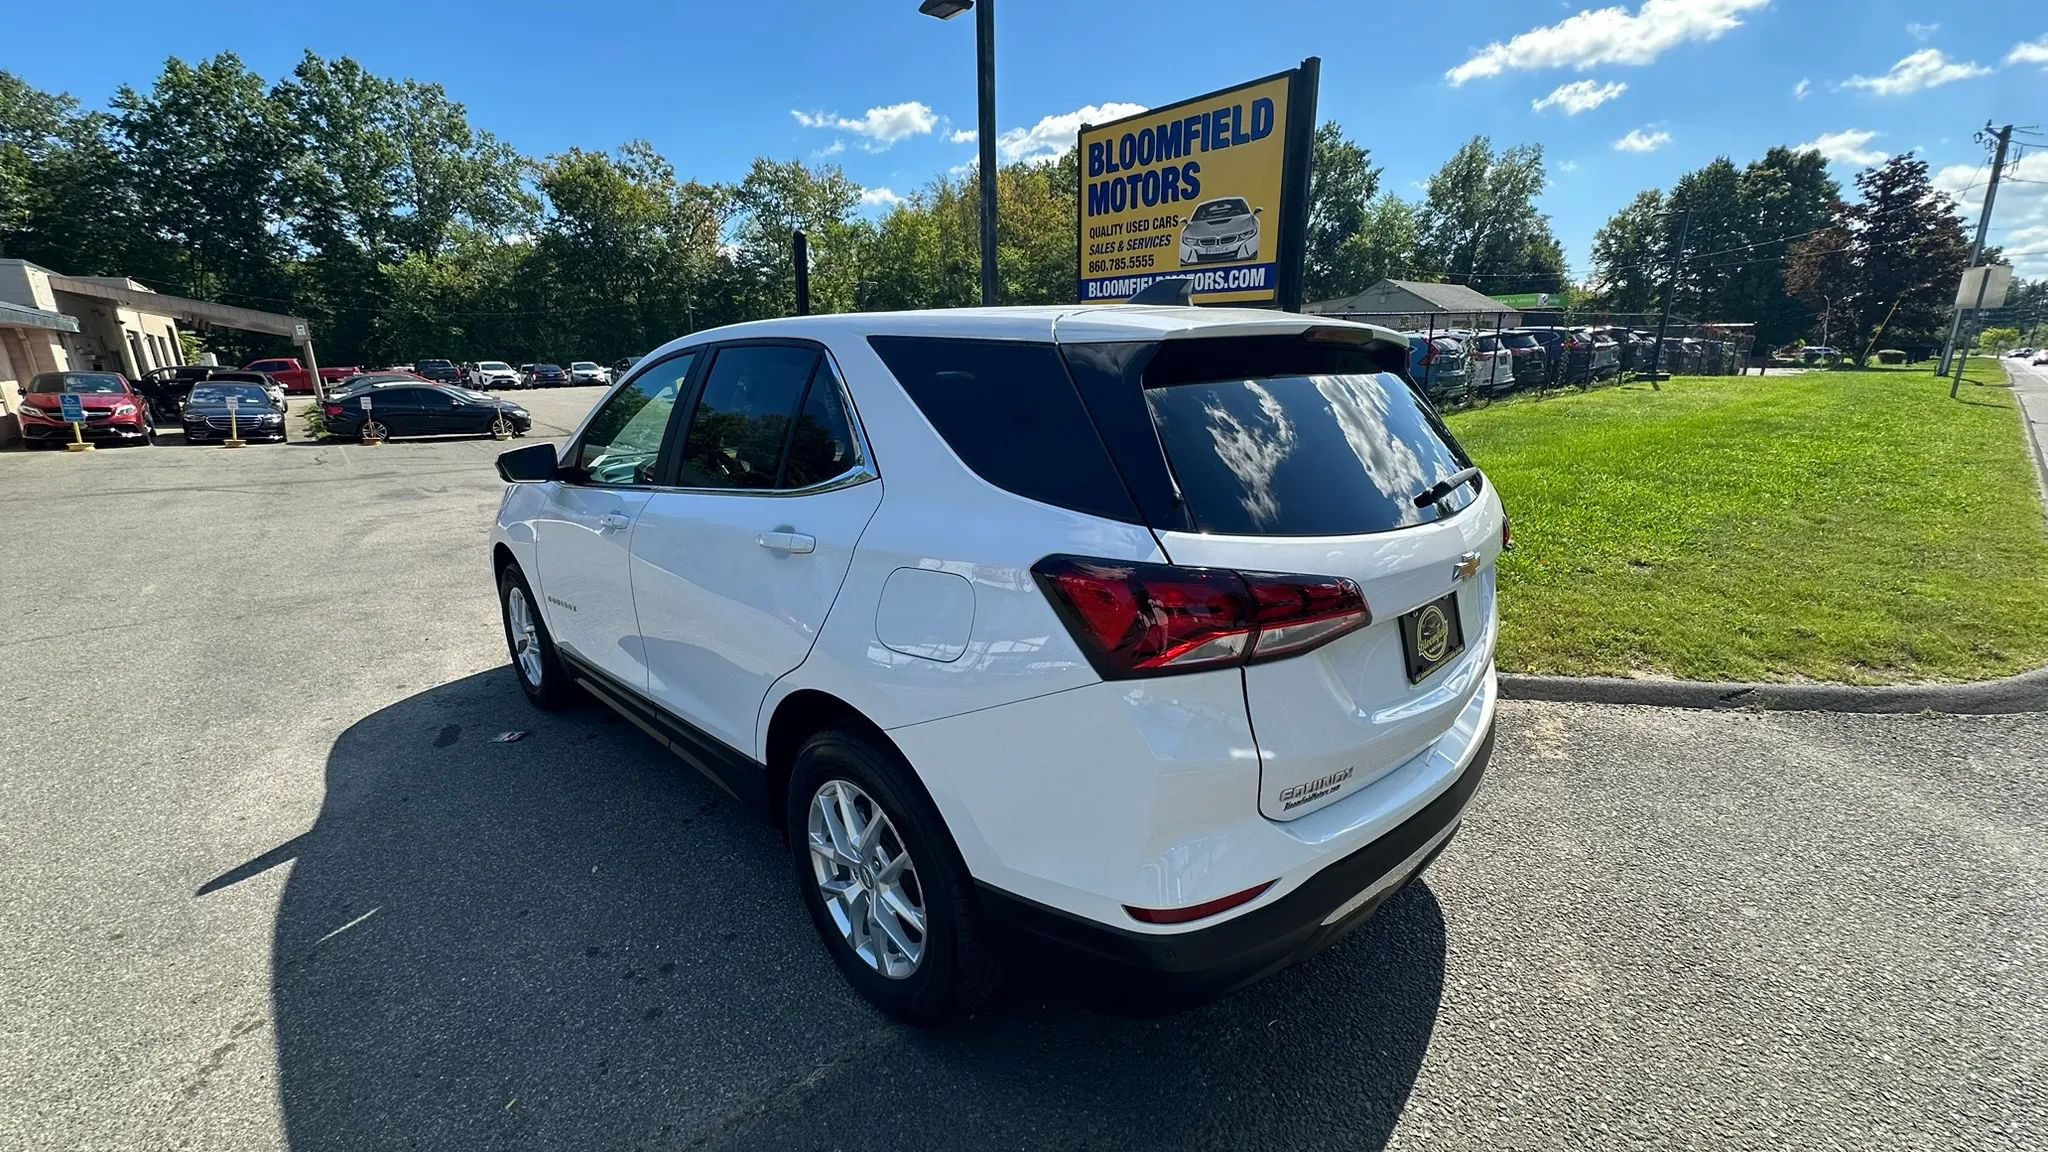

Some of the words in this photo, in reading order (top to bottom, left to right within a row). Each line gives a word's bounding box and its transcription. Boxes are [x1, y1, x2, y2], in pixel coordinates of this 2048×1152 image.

[1088, 97, 1275, 178] BLOOMFIELD
[1088, 161, 1201, 217] MOTORS
[1089, 223, 1124, 239] QUALITY
[1126, 219, 1150, 233] USED
[1152, 215, 1179, 230] CARS
[1089, 241, 1116, 256] SALES
[1117, 242, 1125, 252] &
[1126, 234, 1172, 251] SERVICES
[1088, 254, 1155, 274] 860.785.5555
[1279, 766, 1354, 802] EQUINOX
